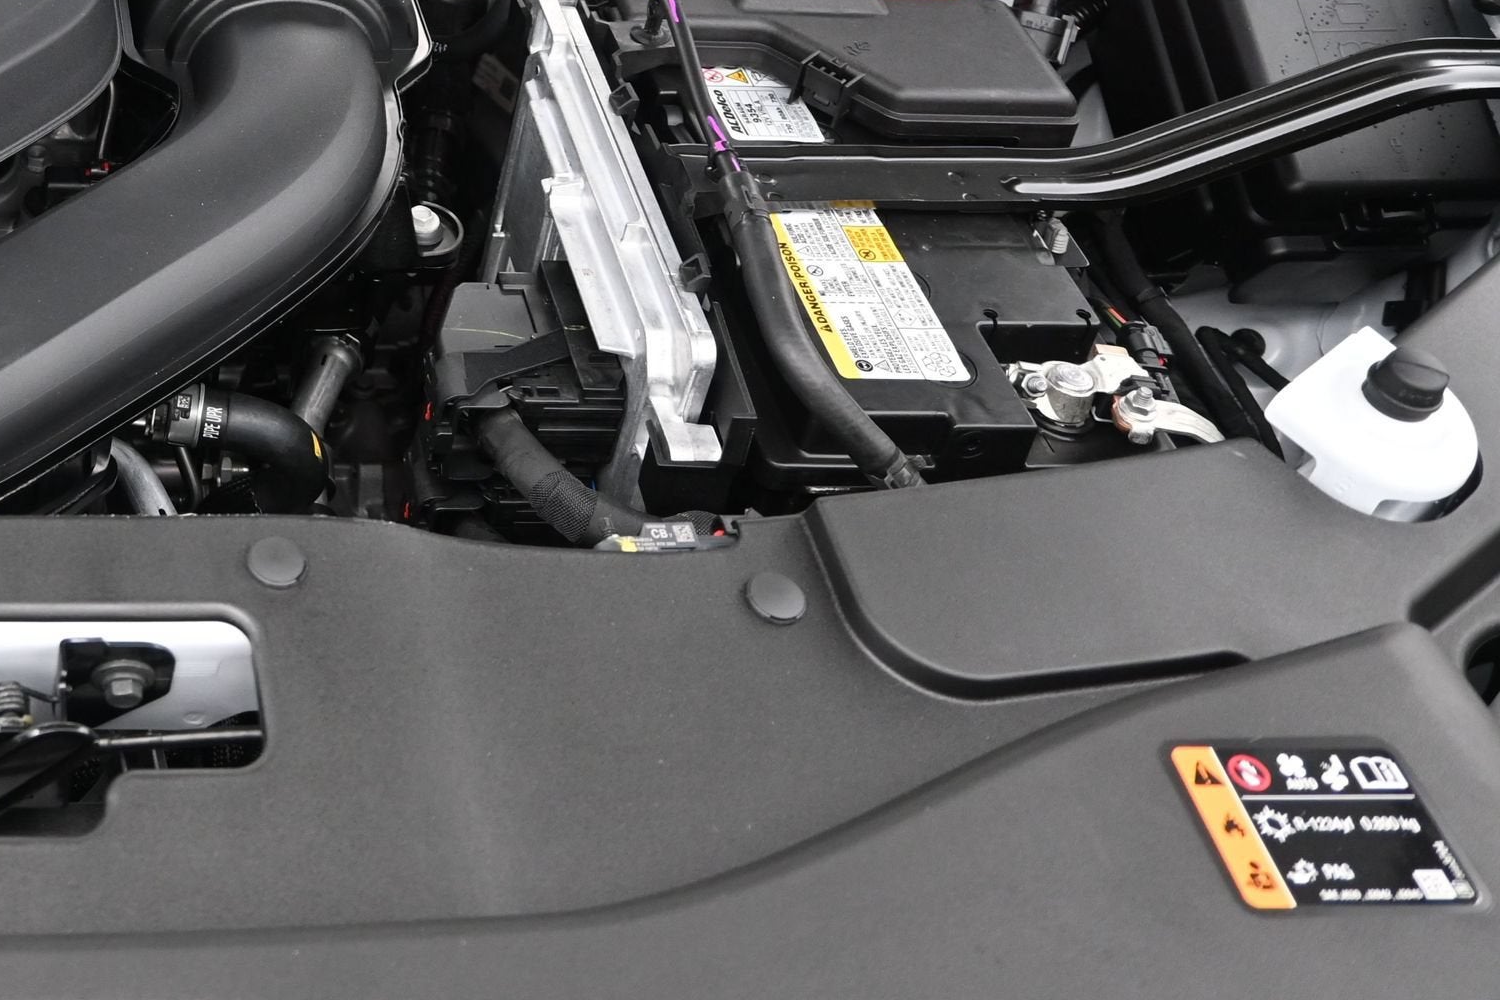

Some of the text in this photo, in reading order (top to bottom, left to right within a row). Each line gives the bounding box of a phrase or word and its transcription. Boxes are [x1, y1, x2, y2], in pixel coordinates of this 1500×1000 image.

[713, 89, 743, 133] ACDelco
[778, 242, 830, 324] DANGER/POISON
[840, 316, 869, 358] EXPLOSIVE GASES
[880, 327, 900, 352] EXPLOSIFS
[894, 354, 905, 363] GAZ
[900, 365, 911, 373] LES
[203, 406, 223, 439] PIPE UPR
[650, 528, 669, 539] CB
